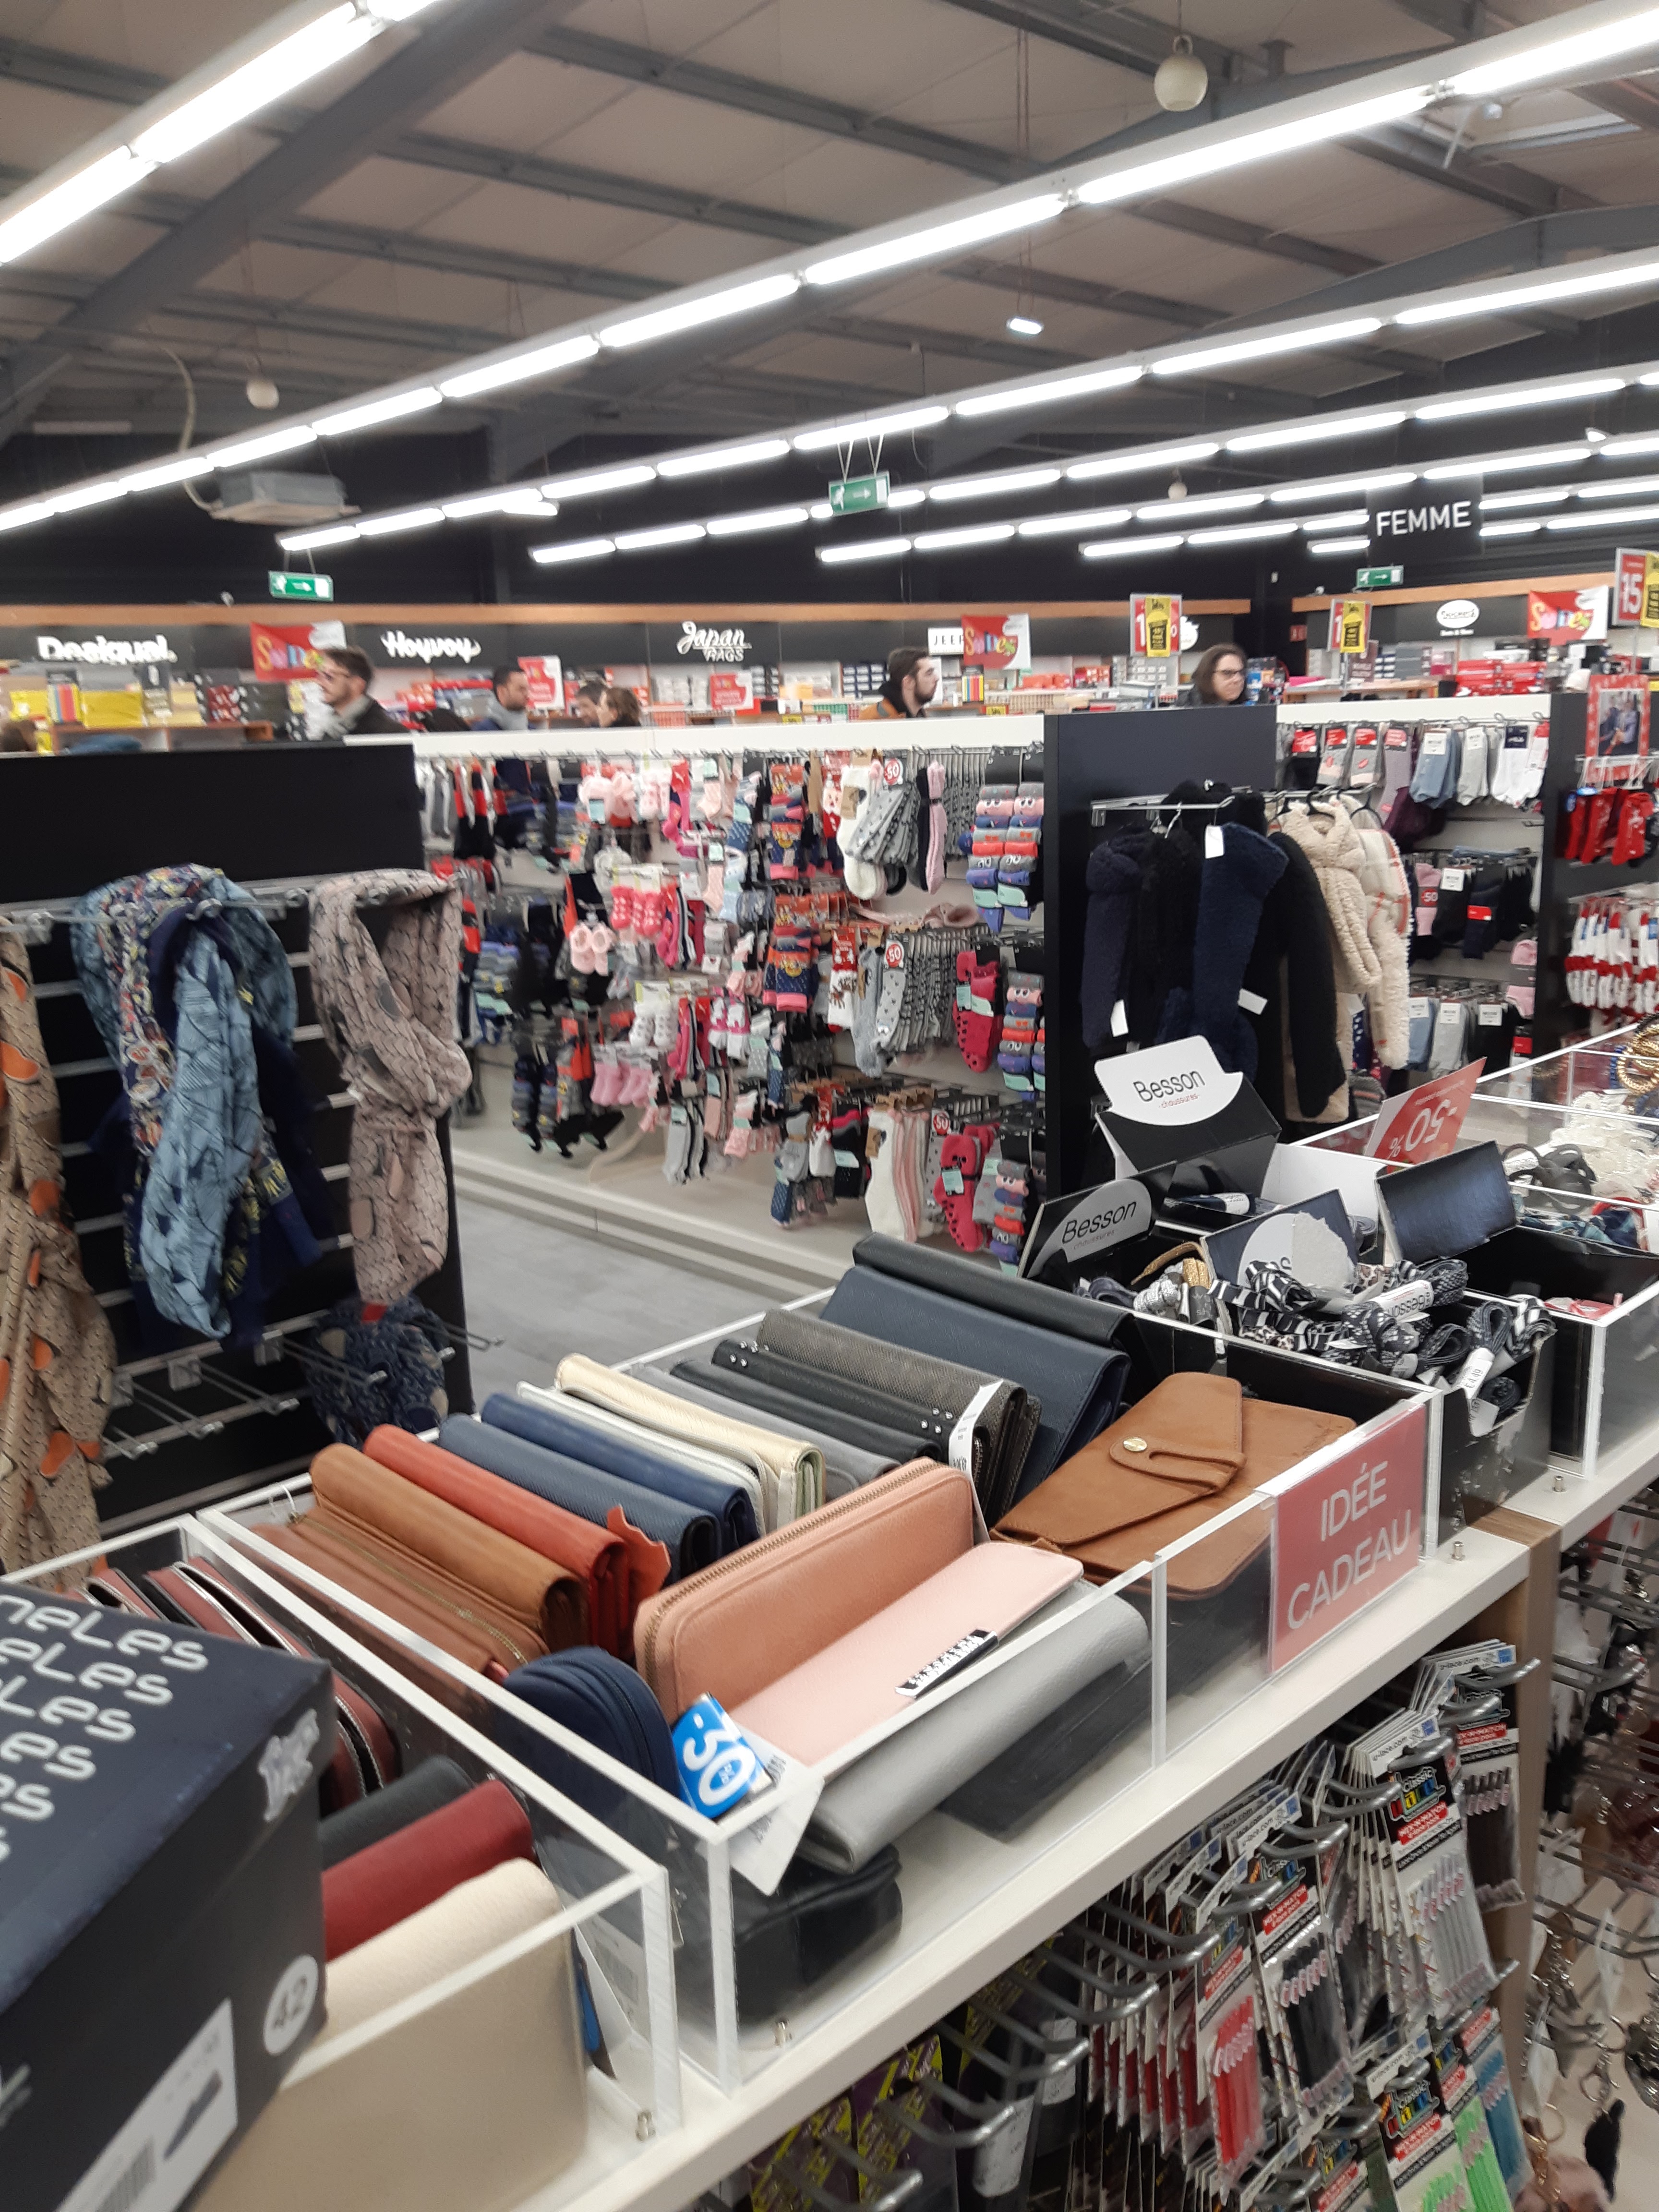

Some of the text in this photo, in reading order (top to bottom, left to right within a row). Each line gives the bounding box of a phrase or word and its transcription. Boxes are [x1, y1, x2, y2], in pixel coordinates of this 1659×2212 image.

[1376, 501, 1472, 537] FEMME
[677, 621, 749, 655] Japan
[1133, 1070, 1206, 1103] Besson
[1061, 1201, 1137, 1244] Besson
[1321, 1460, 1389, 1542] IDÉE
[1287, 1509, 1412, 1629] CADEAU
[683, 1712, 756, 1806] -50
